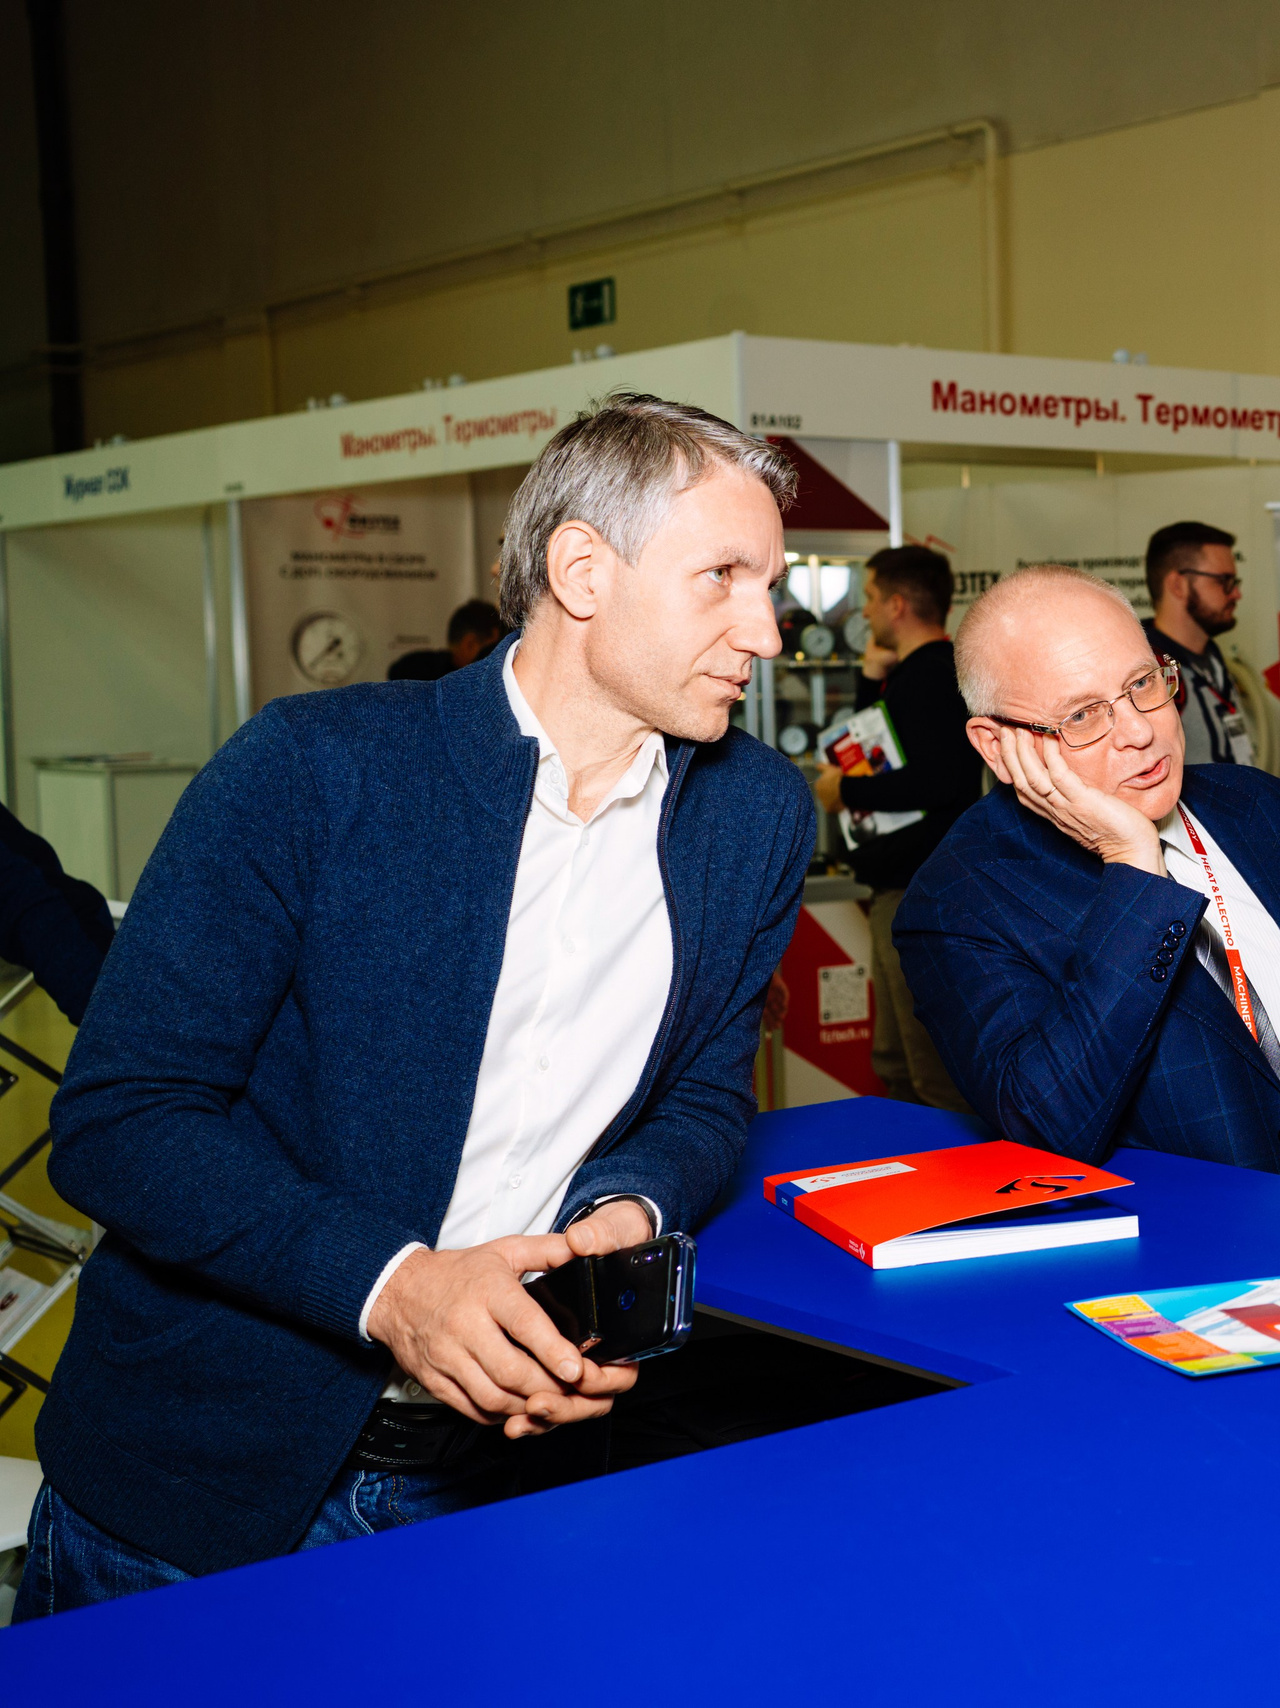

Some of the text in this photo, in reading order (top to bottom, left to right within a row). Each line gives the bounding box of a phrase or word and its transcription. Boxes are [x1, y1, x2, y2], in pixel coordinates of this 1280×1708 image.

[443, 407, 558, 448] Термометры
[931, 379, 1127, 427] Манометры.
[1201, 857, 1235, 947] HEAT & ELECTRO
[1233, 966, 1253, 1032] MACHINER
